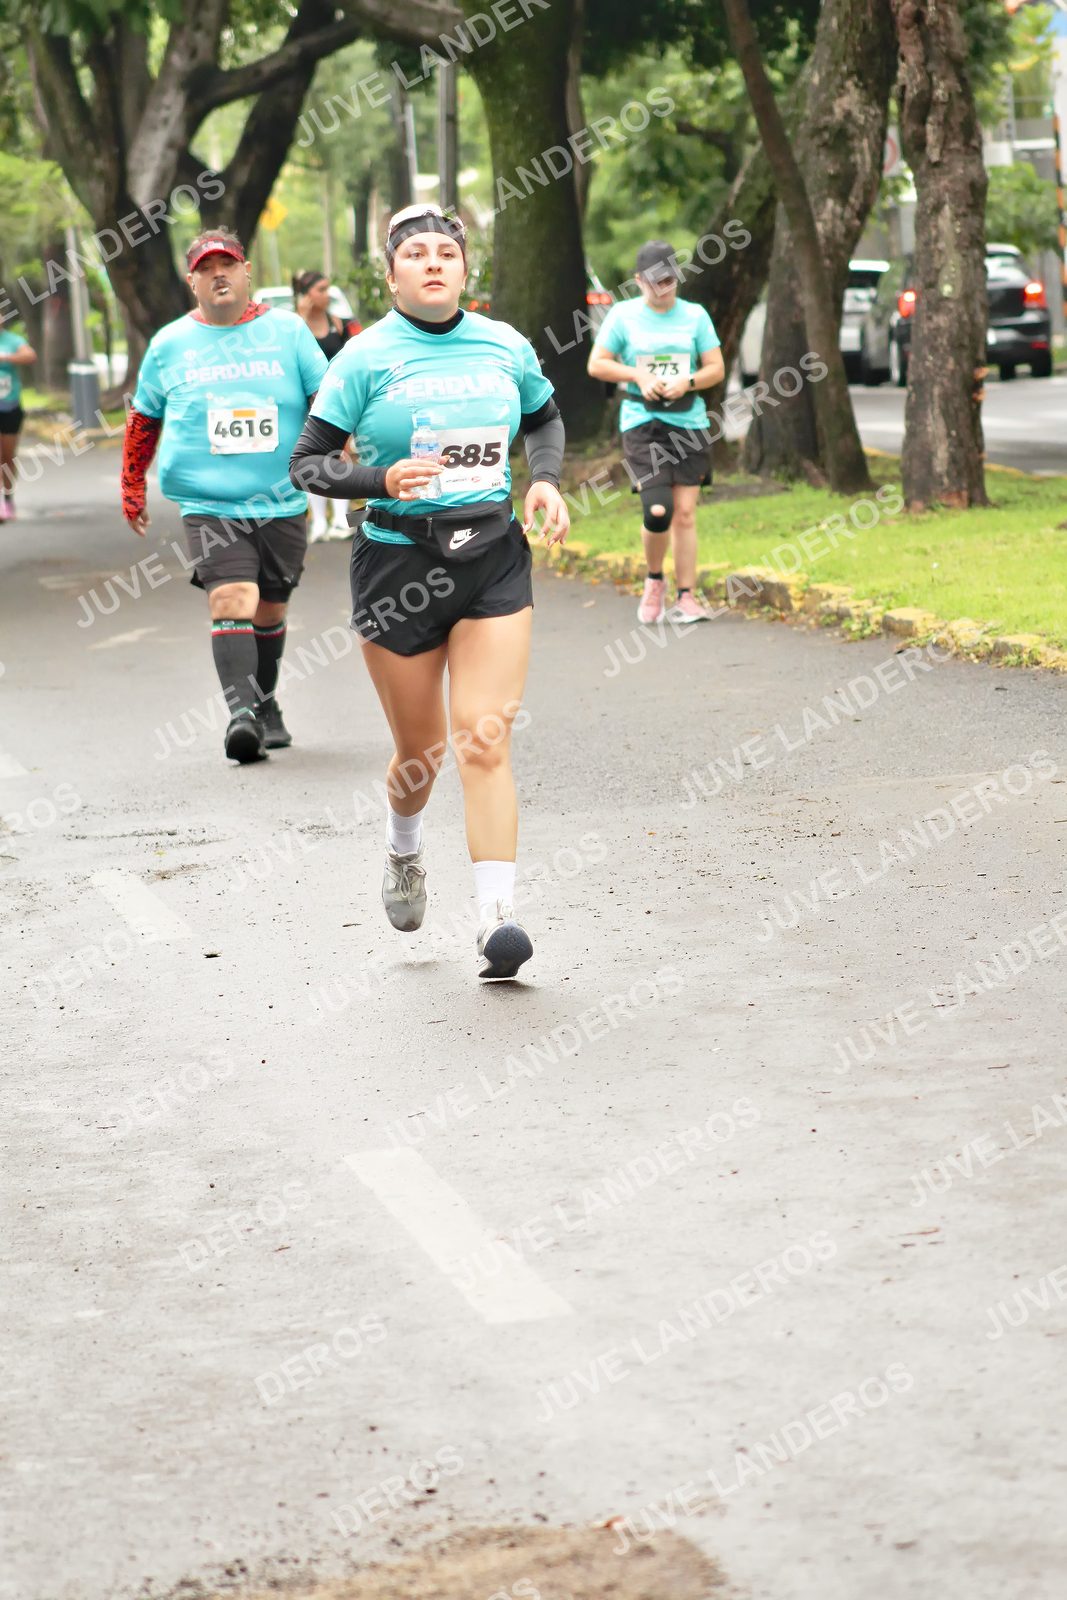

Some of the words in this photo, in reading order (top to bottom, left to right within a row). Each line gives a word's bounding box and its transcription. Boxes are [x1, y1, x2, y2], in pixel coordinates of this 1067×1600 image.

[184, 360, 285, 383] PERDURA
[647, 363, 679, 376] 273
[214, 418, 274, 438] 4616
